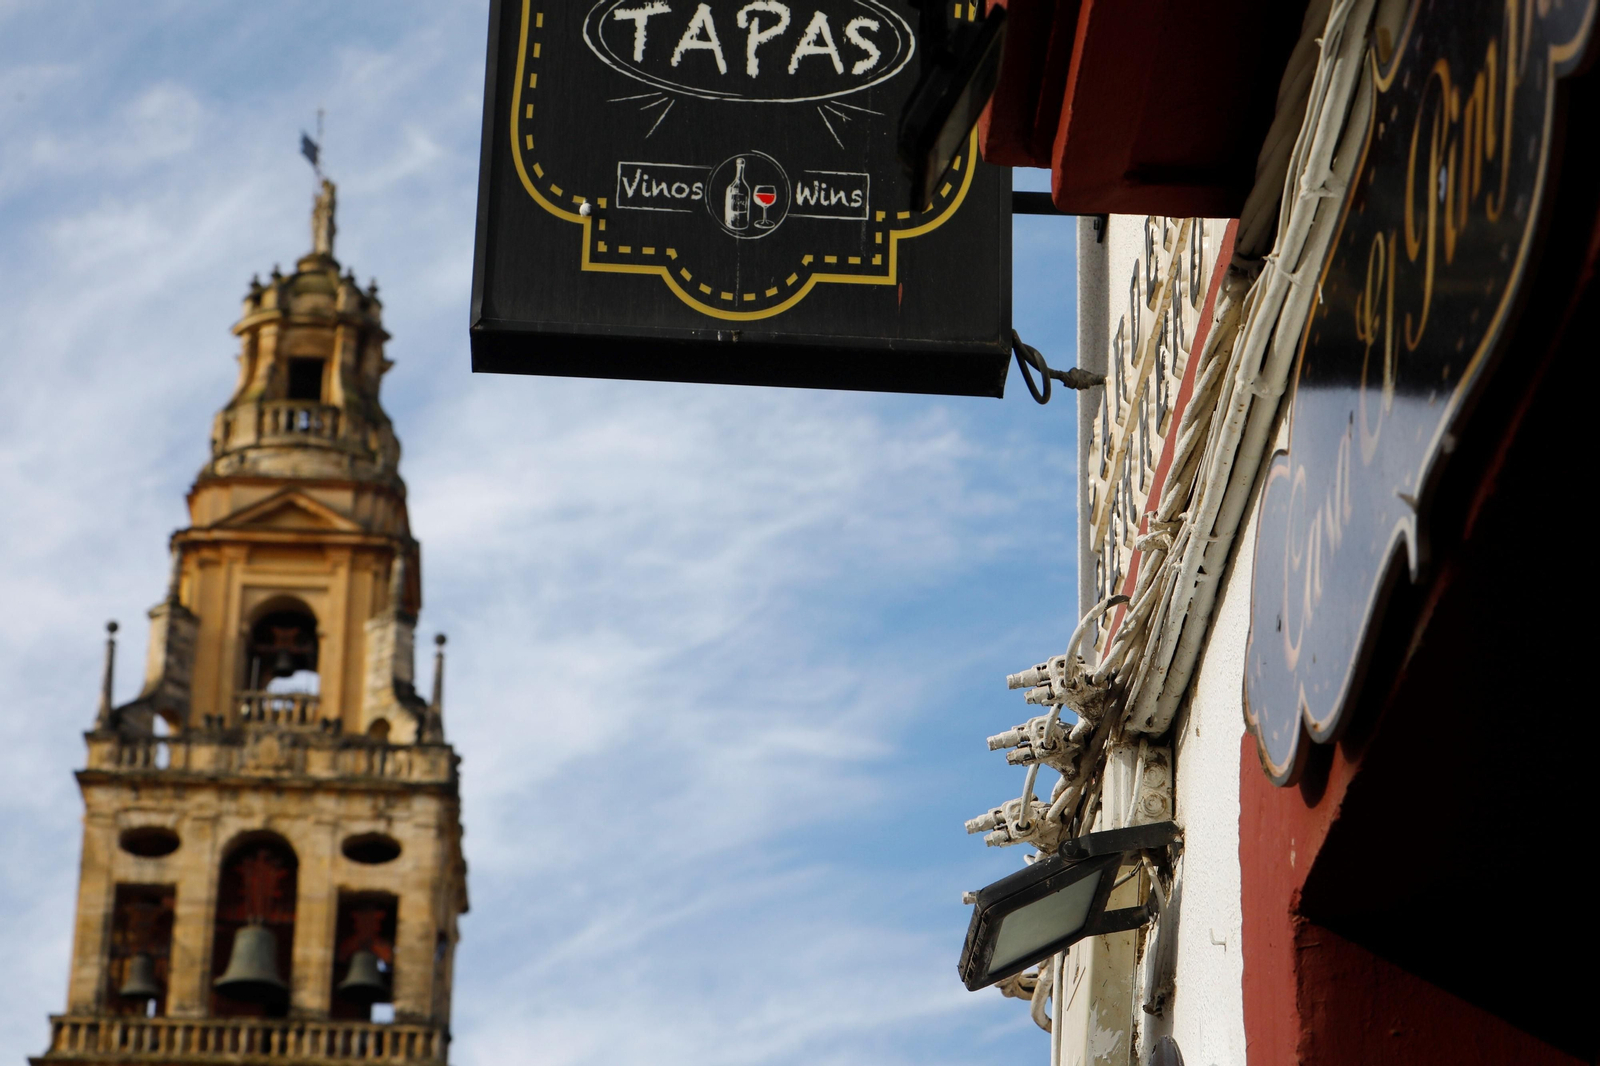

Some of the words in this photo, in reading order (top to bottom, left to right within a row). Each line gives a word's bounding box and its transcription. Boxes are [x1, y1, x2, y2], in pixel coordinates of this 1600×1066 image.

[613, 0, 882, 78] TAPAS
[622, 168, 703, 200] Vinos
[796, 181, 862, 208] Wins
